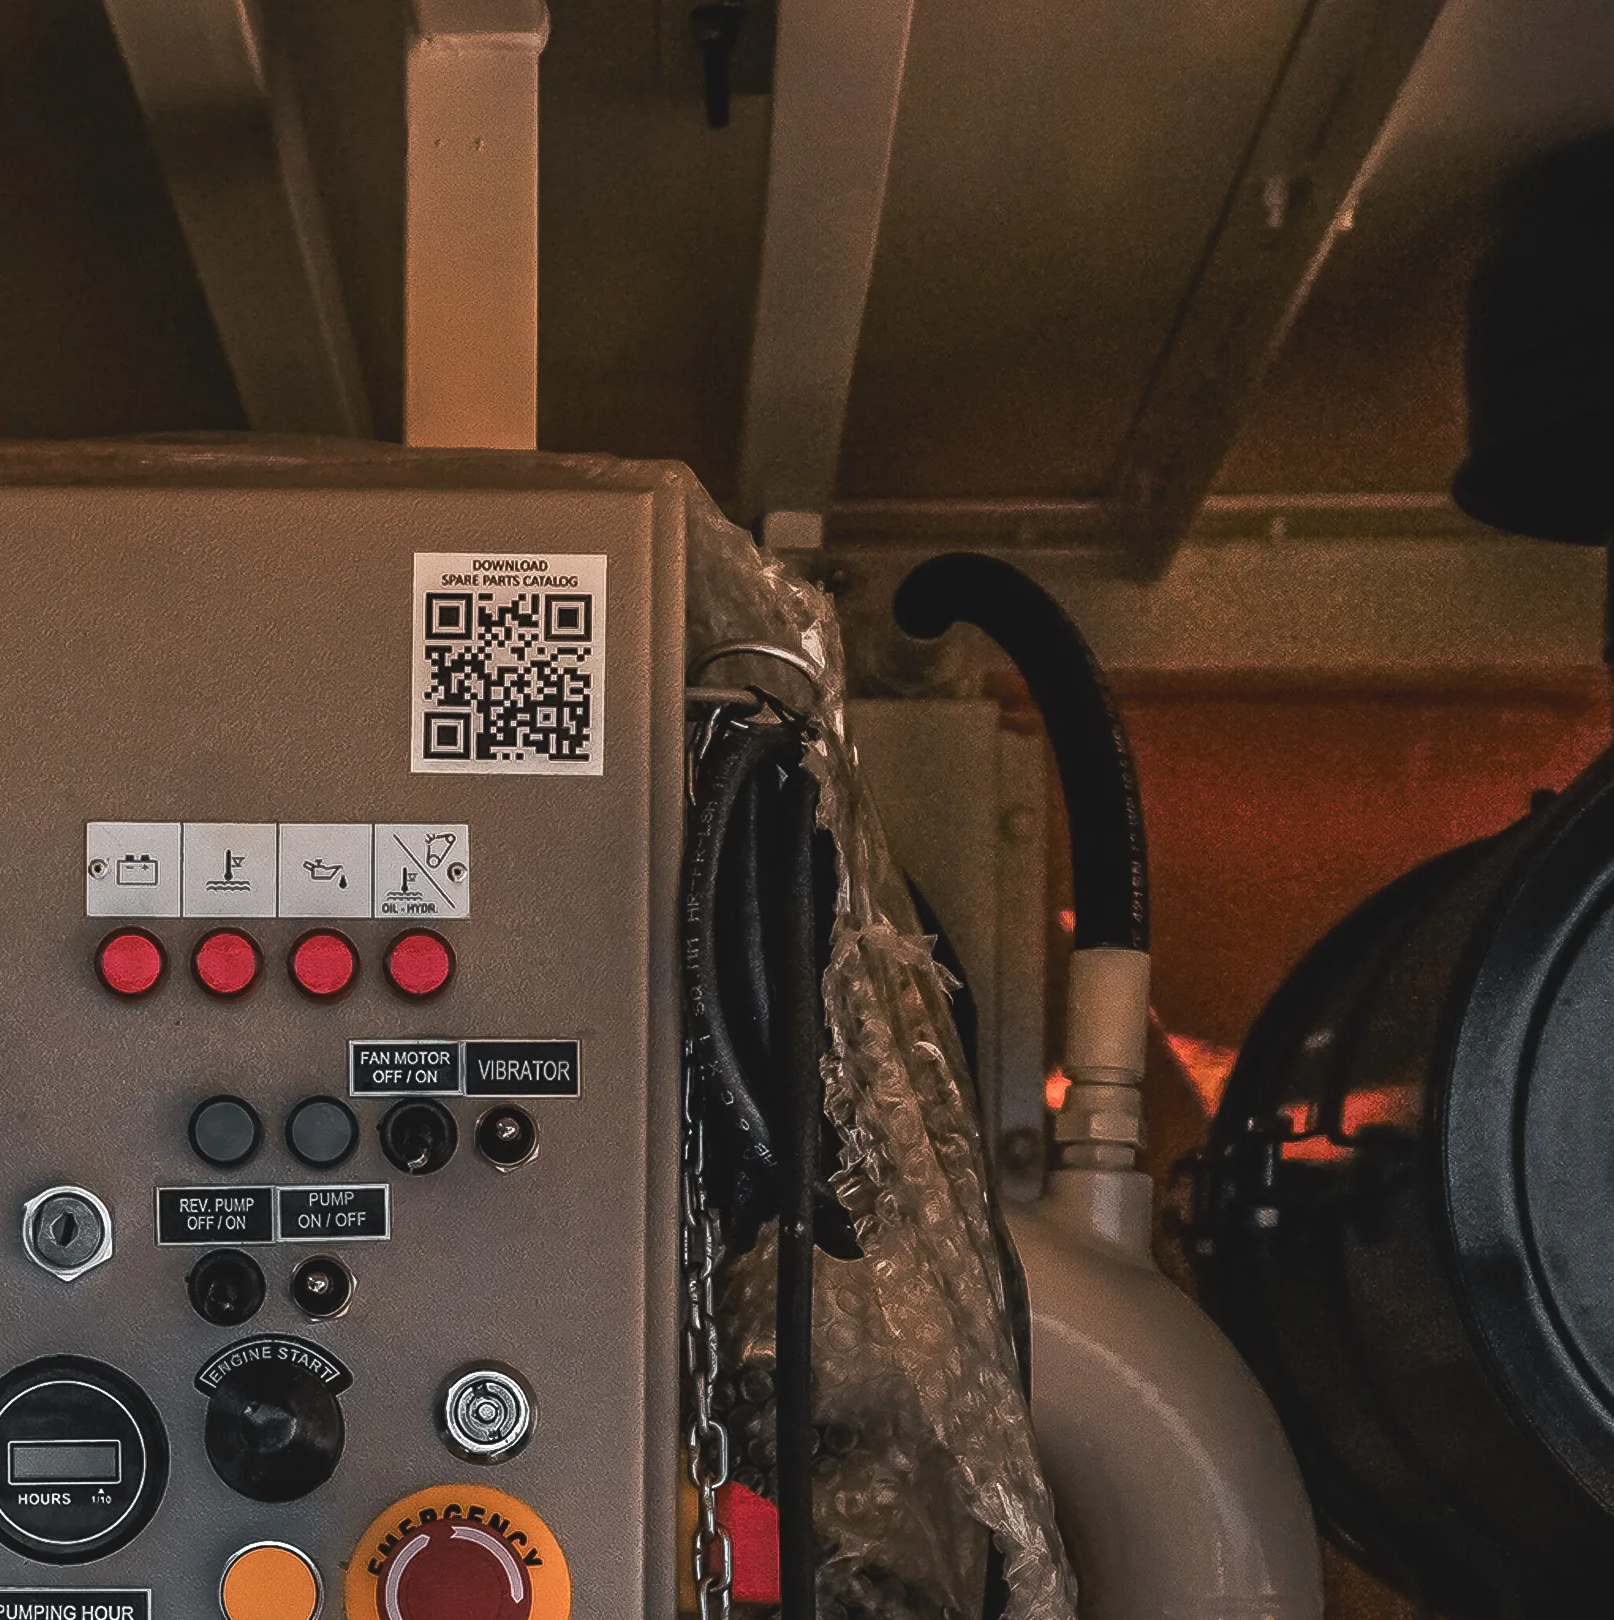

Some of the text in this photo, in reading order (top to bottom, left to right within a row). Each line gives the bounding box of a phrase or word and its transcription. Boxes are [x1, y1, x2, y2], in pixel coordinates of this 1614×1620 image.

[472, 560, 548, 572] DOWNLOAD
[441, 574, 578, 588] SPARE PARTS CATALOG
[382, 903, 398, 914] OIL
[360, 1051, 451, 1065] FAN MOTOR
[373, 1070, 402, 1083] OFF
[415, 1070, 438, 1083] ON
[478, 1060, 570, 1081] VIBRATOR
[179, 1198, 255, 1213] REV. PUMP
[309, 1192, 355, 1206] PUMP
[187, 1216, 214, 1230] OFF
[225, 1215, 246, 1230] ON
[298, 1214, 322, 1229] ON
[335, 1212, 367, 1227] OFF
[208, 1346, 334, 1384] ENGINE START
[18, 1492, 72, 1506] HOURS
